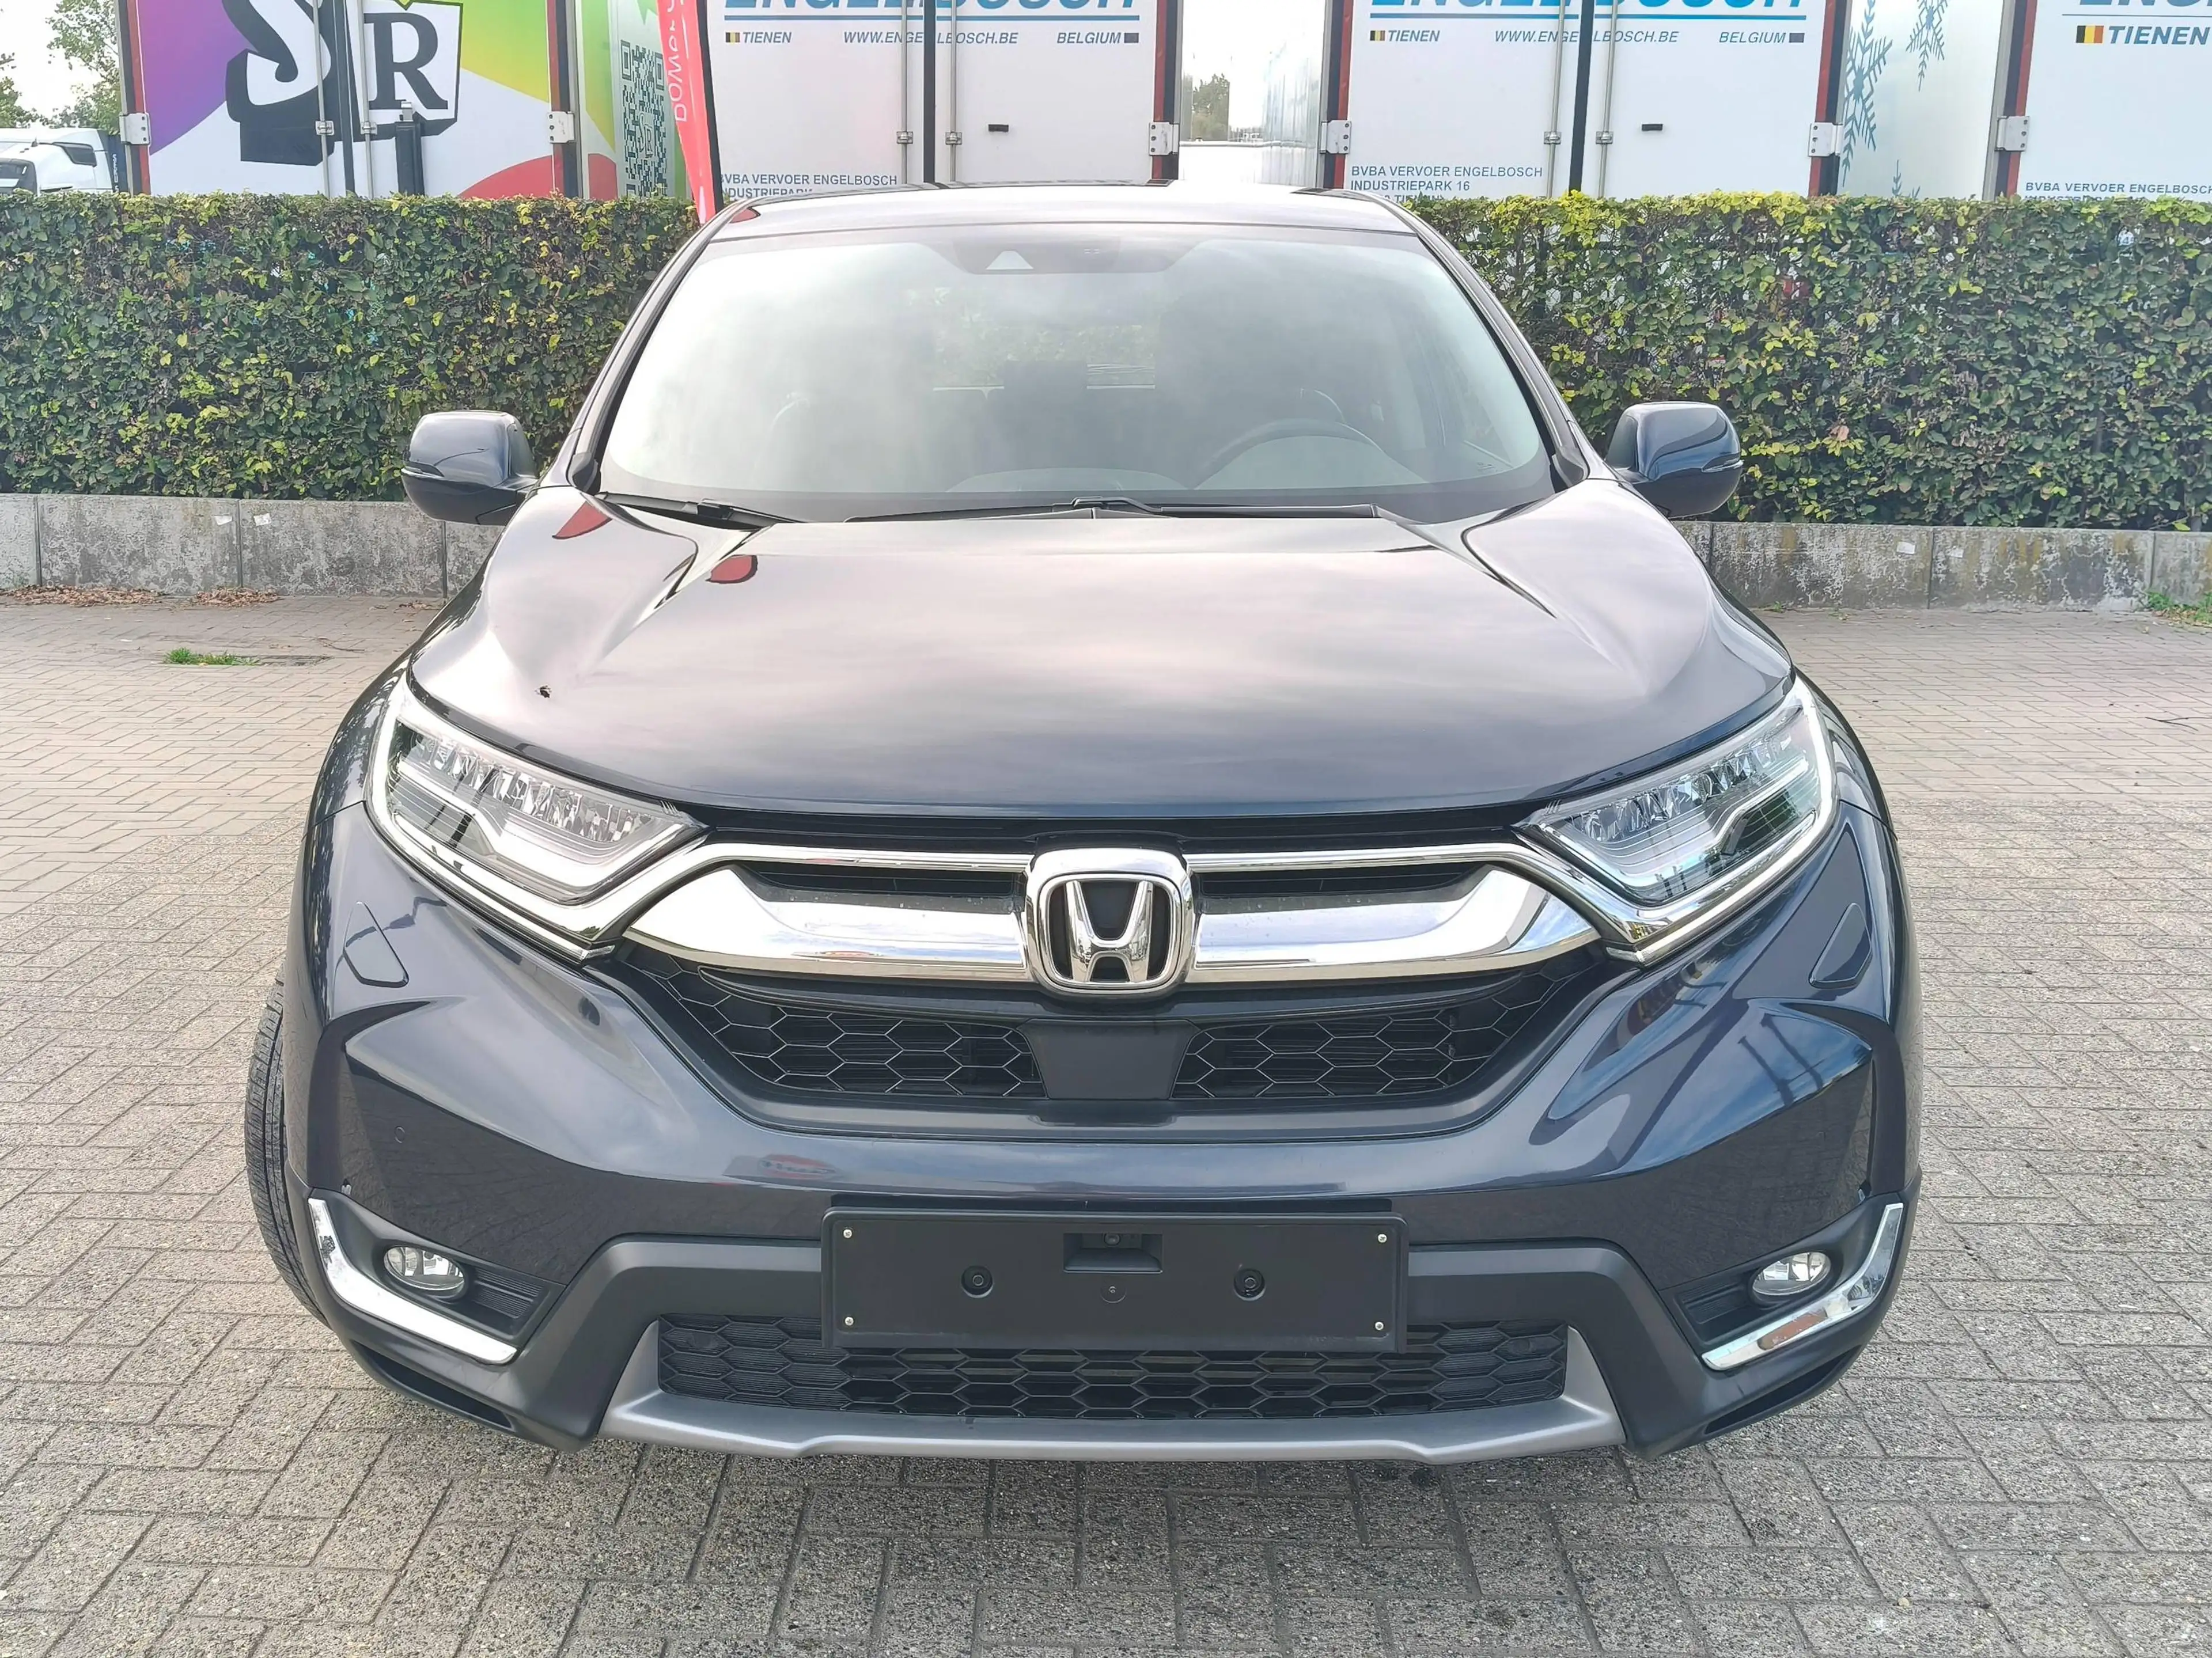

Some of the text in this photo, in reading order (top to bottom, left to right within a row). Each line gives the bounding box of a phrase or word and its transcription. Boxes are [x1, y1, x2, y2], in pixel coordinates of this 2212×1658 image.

[742, 32, 792, 43] TIENEN
[1056, 32, 1122, 44] BELGIUM
[1388, 30, 1440, 42] TIENEN
[1718, 32, 1786, 43] BELGIUM
[2108, 25, 2211, 45] TIENEN
[1351, 166, 1543, 177] BVBA VERVOER ENGELBOSCH
[752, 174, 809, 185] VERVOER
[813, 175, 897, 185] ENGELBOSCH
[1350, 180, 1470, 191] INDUSTRIEPARK 16
[2025, 182, 2061, 192] BVBA
[2065, 183, 2125, 192] VERVOER
